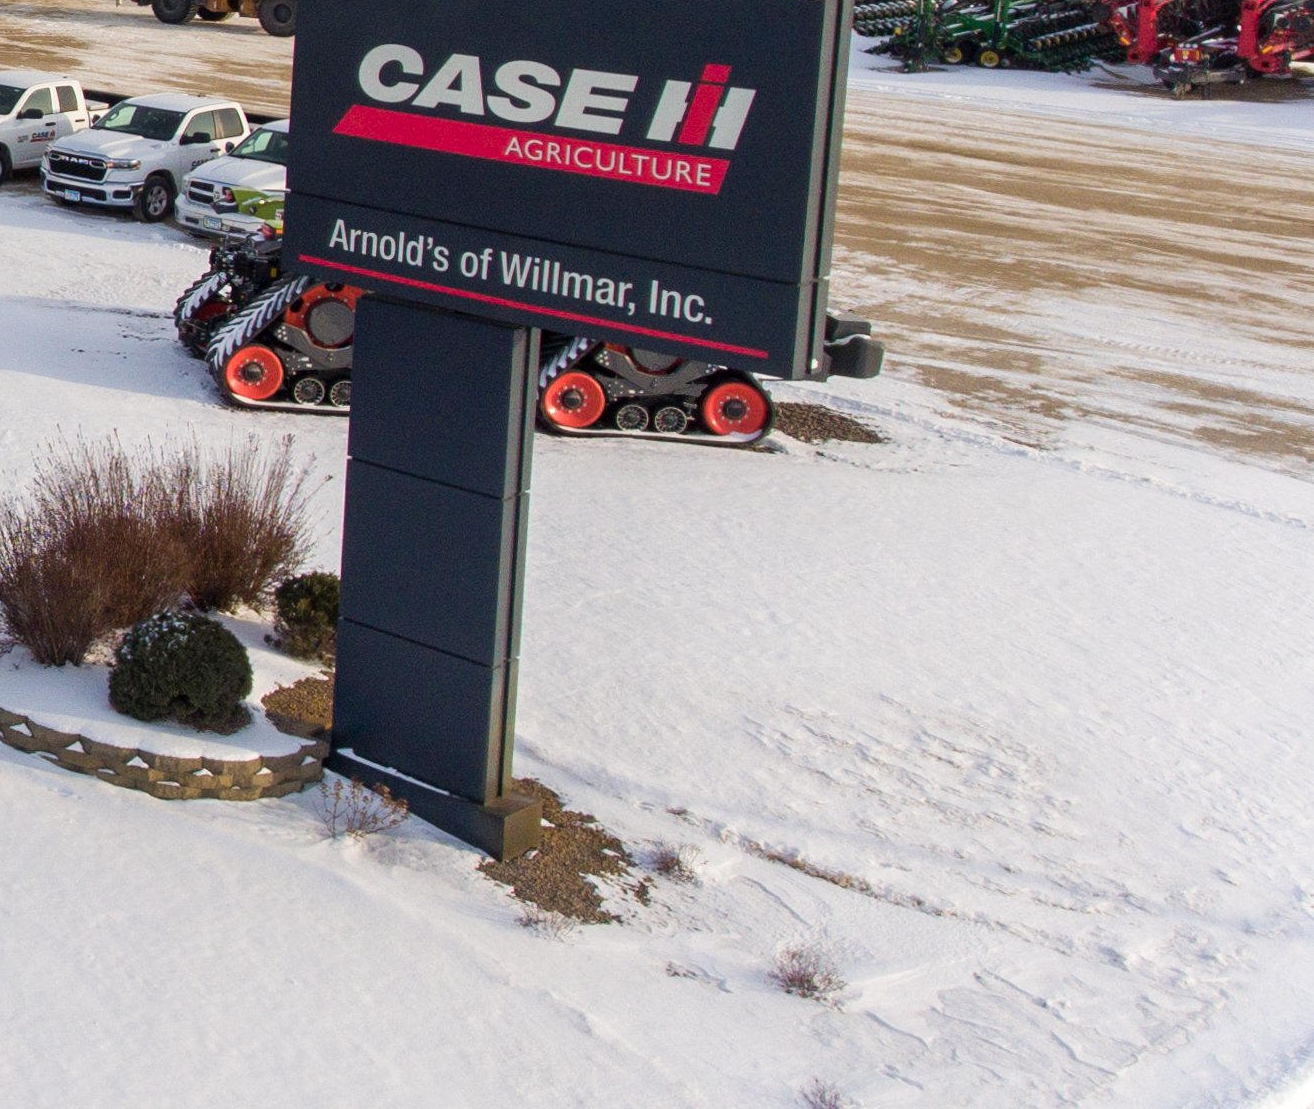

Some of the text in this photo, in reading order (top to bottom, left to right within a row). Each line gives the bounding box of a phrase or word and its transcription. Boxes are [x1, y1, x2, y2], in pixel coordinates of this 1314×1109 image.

[358, 43, 640, 135] CASE
[31, 131, 50, 139] CASE
[59, 154, 89, 165] RAM
[504, 136, 712, 187] AGRICULTURE
[328, 218, 714, 325] Arnold's of Willmar, Inc.
